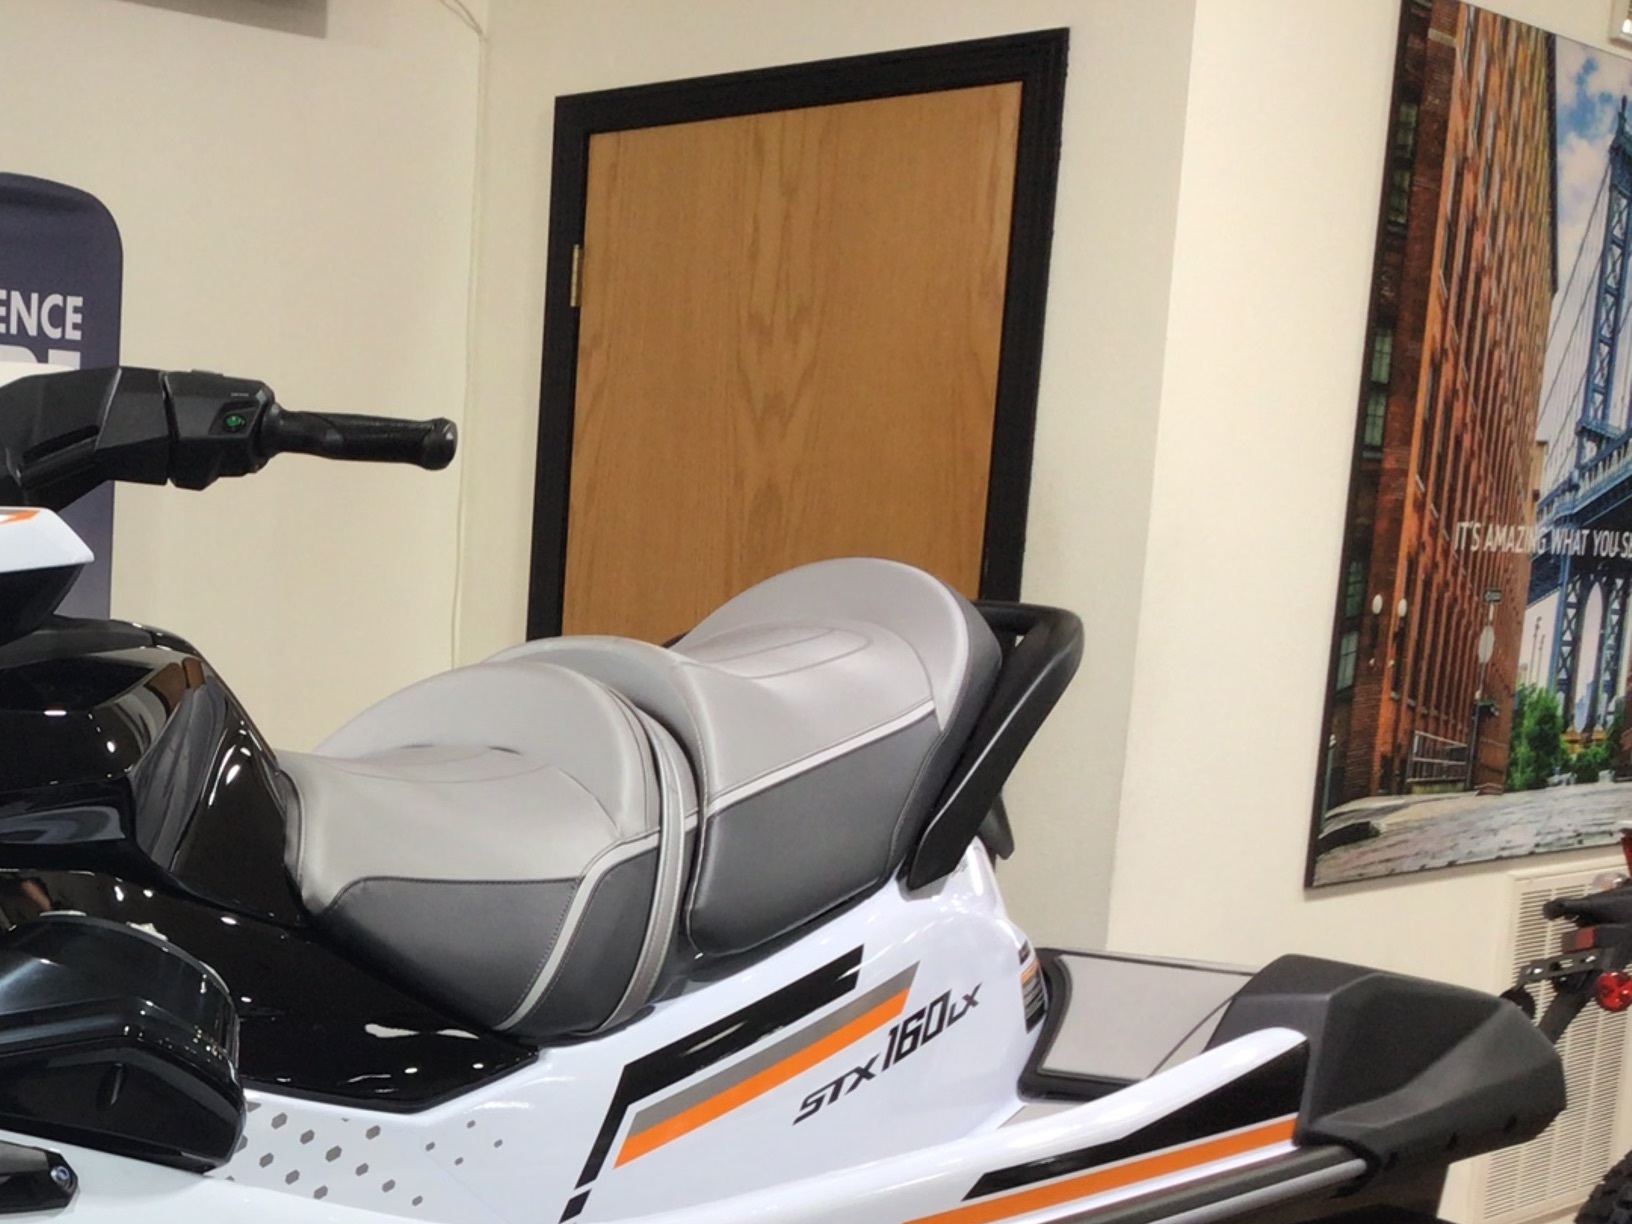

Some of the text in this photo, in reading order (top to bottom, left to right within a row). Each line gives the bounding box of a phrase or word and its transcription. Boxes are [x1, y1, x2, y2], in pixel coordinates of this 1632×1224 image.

[1454, 520, 1481, 552] IT'S
[1482, 523, 1548, 554] AMAZING
[1551, 528, 1590, 556] WHAT
[1593, 529, 1620, 558] YOU
